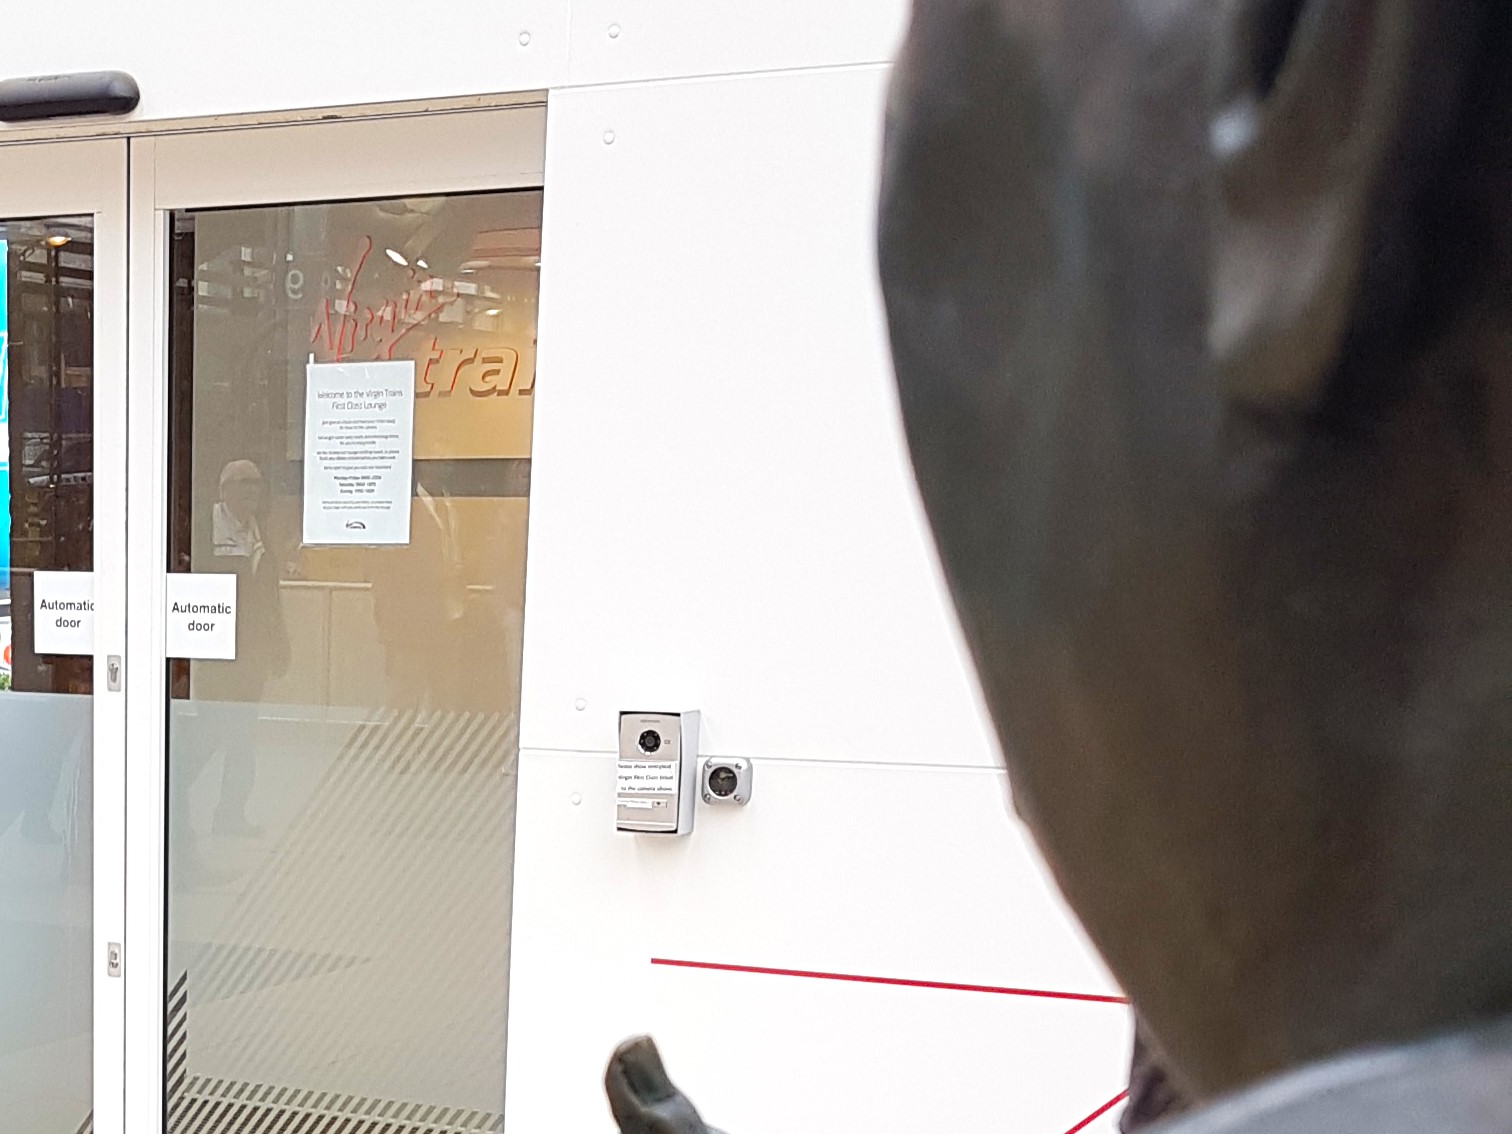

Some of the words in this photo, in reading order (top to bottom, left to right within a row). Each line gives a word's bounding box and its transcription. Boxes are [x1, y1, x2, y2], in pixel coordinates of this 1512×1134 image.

[40, 598, 95, 612] Automatic
[171, 602, 232, 615] Automatic
[55, 616, 82, 629] door
[187, 620, 216, 632] door
